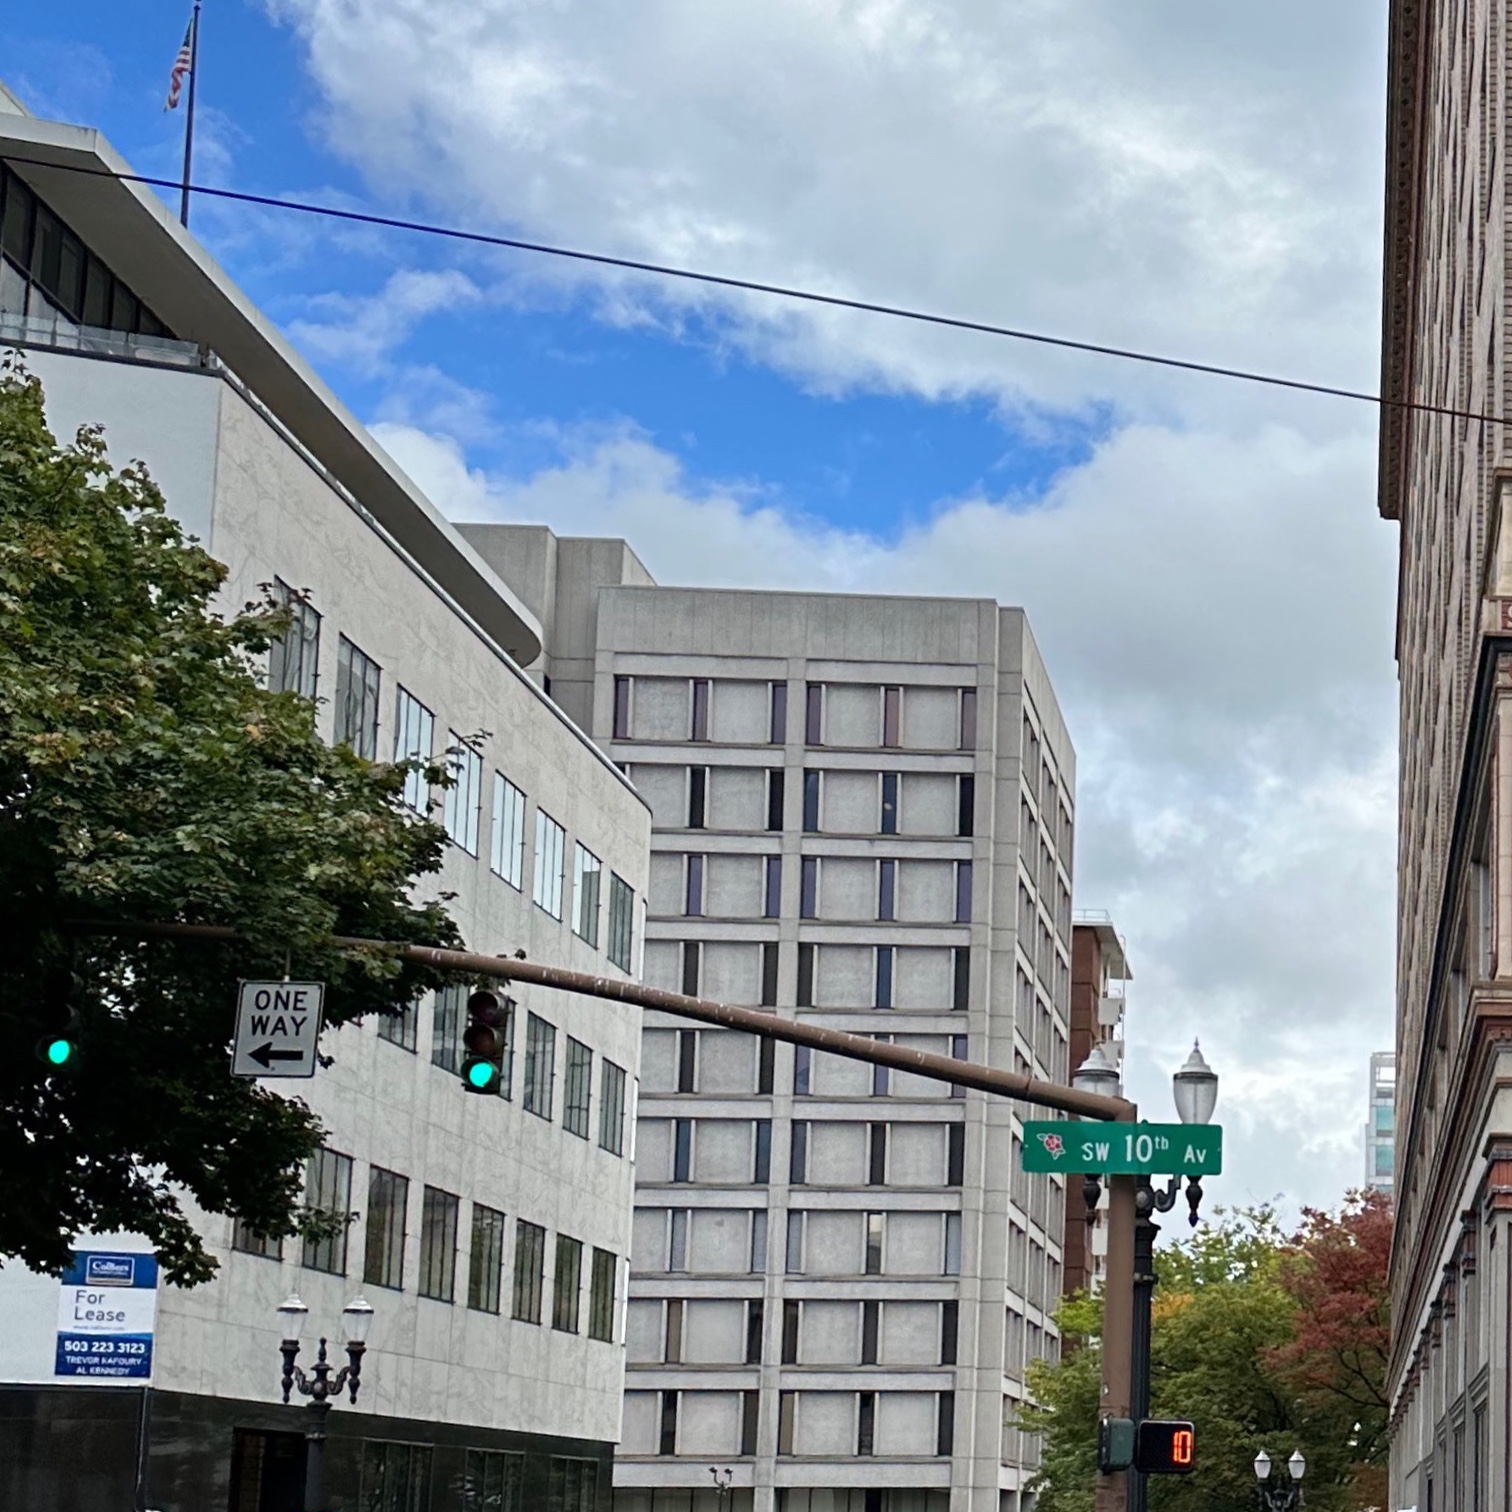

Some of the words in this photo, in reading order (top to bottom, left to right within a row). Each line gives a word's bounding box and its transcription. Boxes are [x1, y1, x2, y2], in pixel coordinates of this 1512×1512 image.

[254, 990, 308, 1011] ONE
[251, 1015, 308, 1036] WAY
[1082, 1142, 1110, 1162] SW
[1124, 1134, 1169, 1163] 10th
[1183, 1145, 1207, 1163] Av
[75, 1290, 105, 1304] For
[74, 1306, 126, 1322] Lease
[64, 1341, 88, 1352] 503
[91, 1342, 115, 1352] 223
[117, 1343, 145, 1354] 3123
[1173, 1431, 1191, 1463] 10
